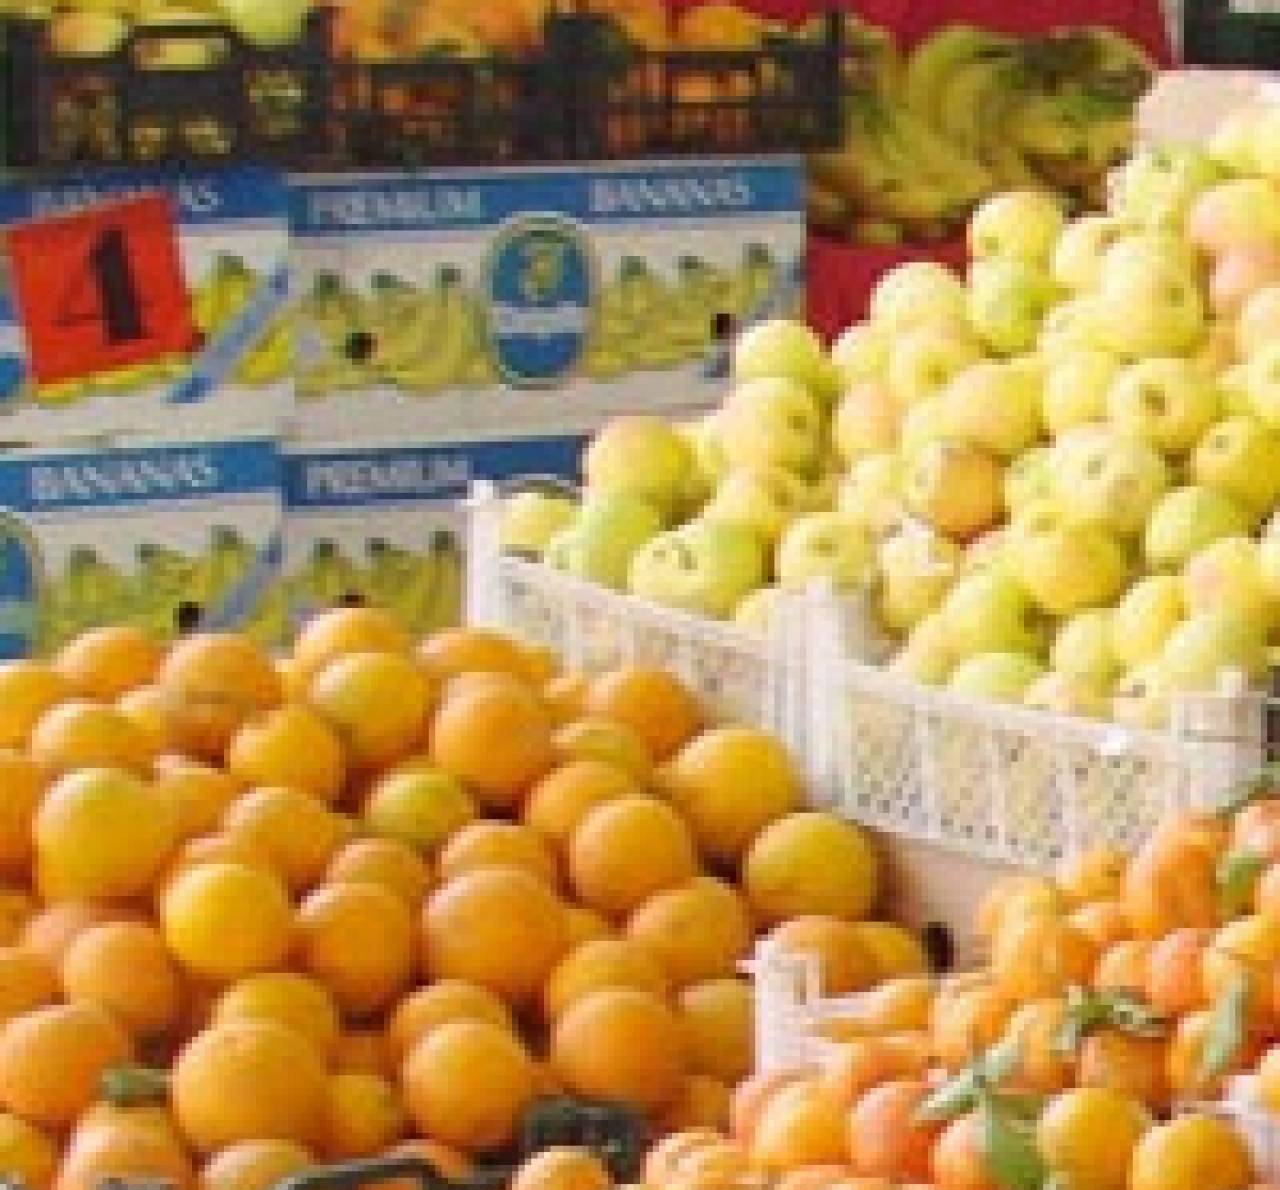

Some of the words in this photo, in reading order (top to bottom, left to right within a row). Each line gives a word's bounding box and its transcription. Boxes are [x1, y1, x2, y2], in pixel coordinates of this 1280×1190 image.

[311, 190, 481, 225] PREMIUM
[592, 177, 750, 212] BANANAS
[31, 455, 219, 501] BANANAS
[306, 458, 469, 496] PREMIUM
